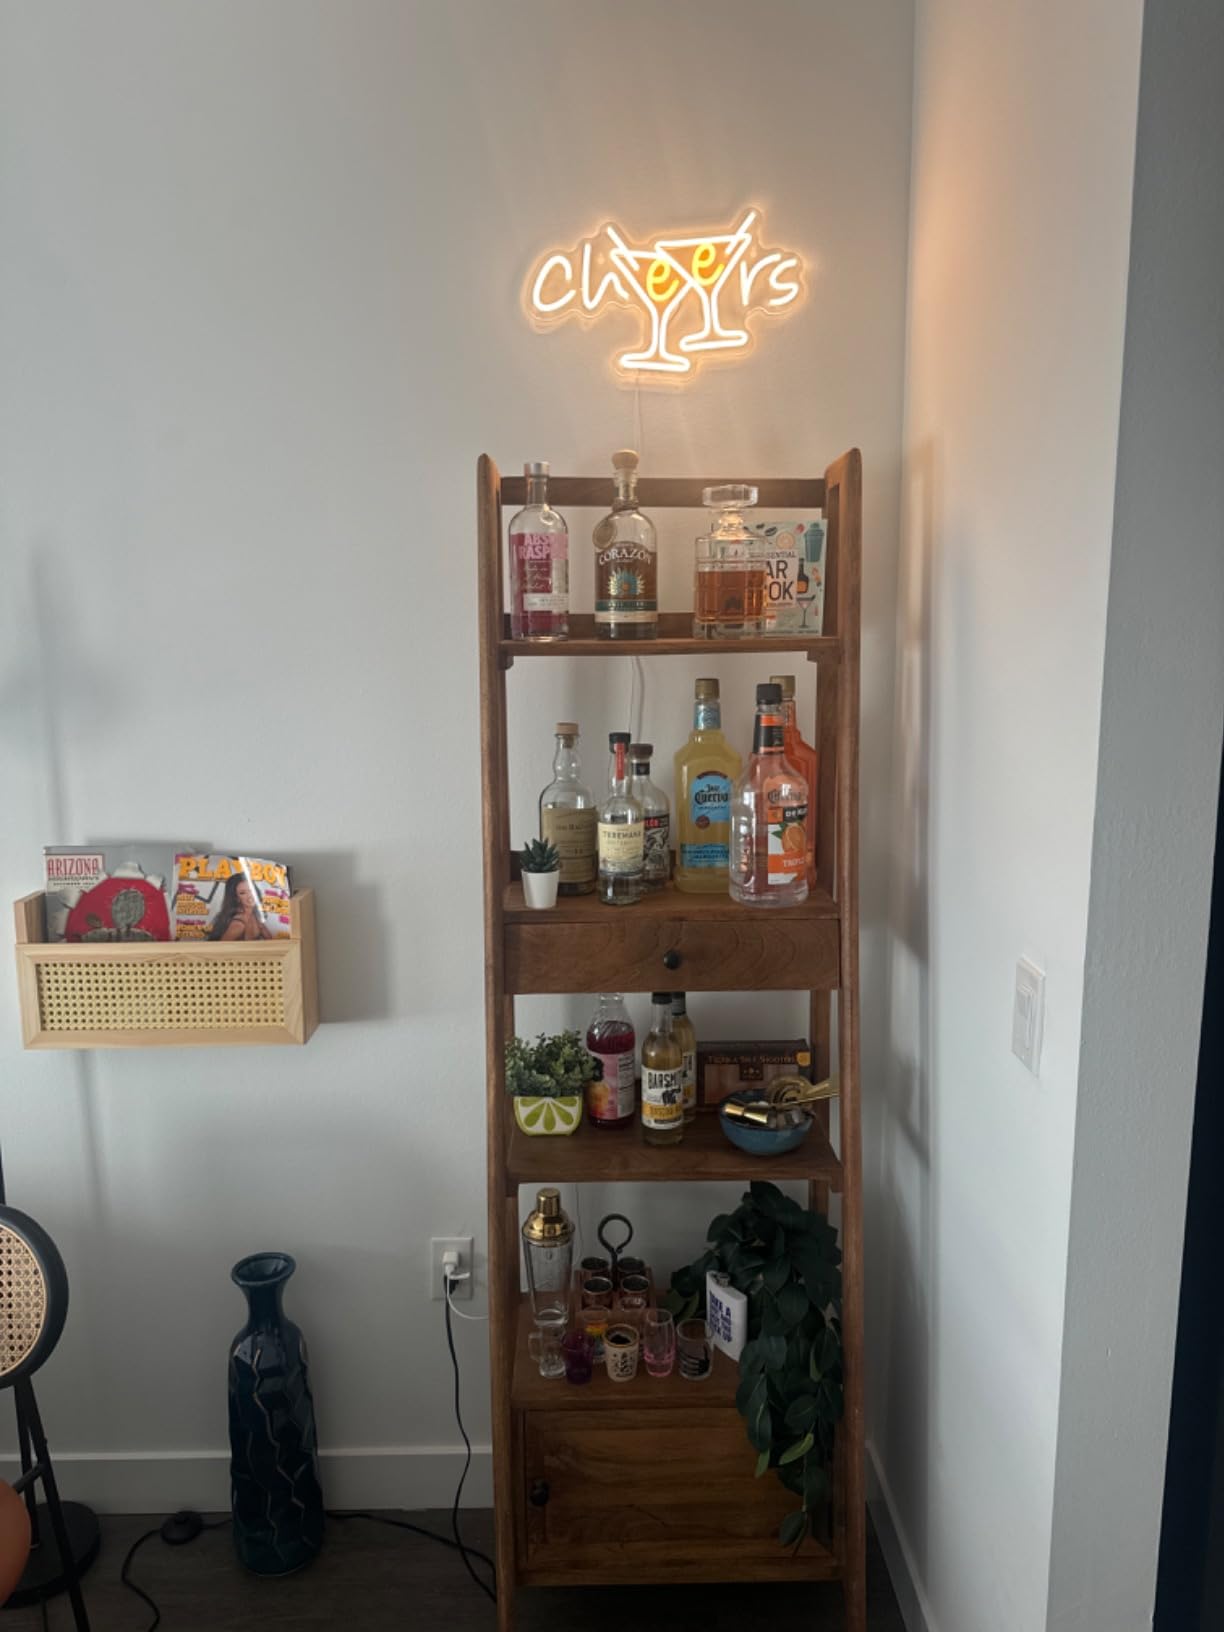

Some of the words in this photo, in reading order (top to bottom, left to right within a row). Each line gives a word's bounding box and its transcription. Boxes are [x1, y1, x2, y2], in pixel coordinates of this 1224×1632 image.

[766, 560, 788, 579] AR
[769, 580, 794, 601] OK
[695, 790, 730, 805] Cuervo
[48, 858, 99, 877] ARIZONA
[179, 855, 288, 889] PLAYBOY
